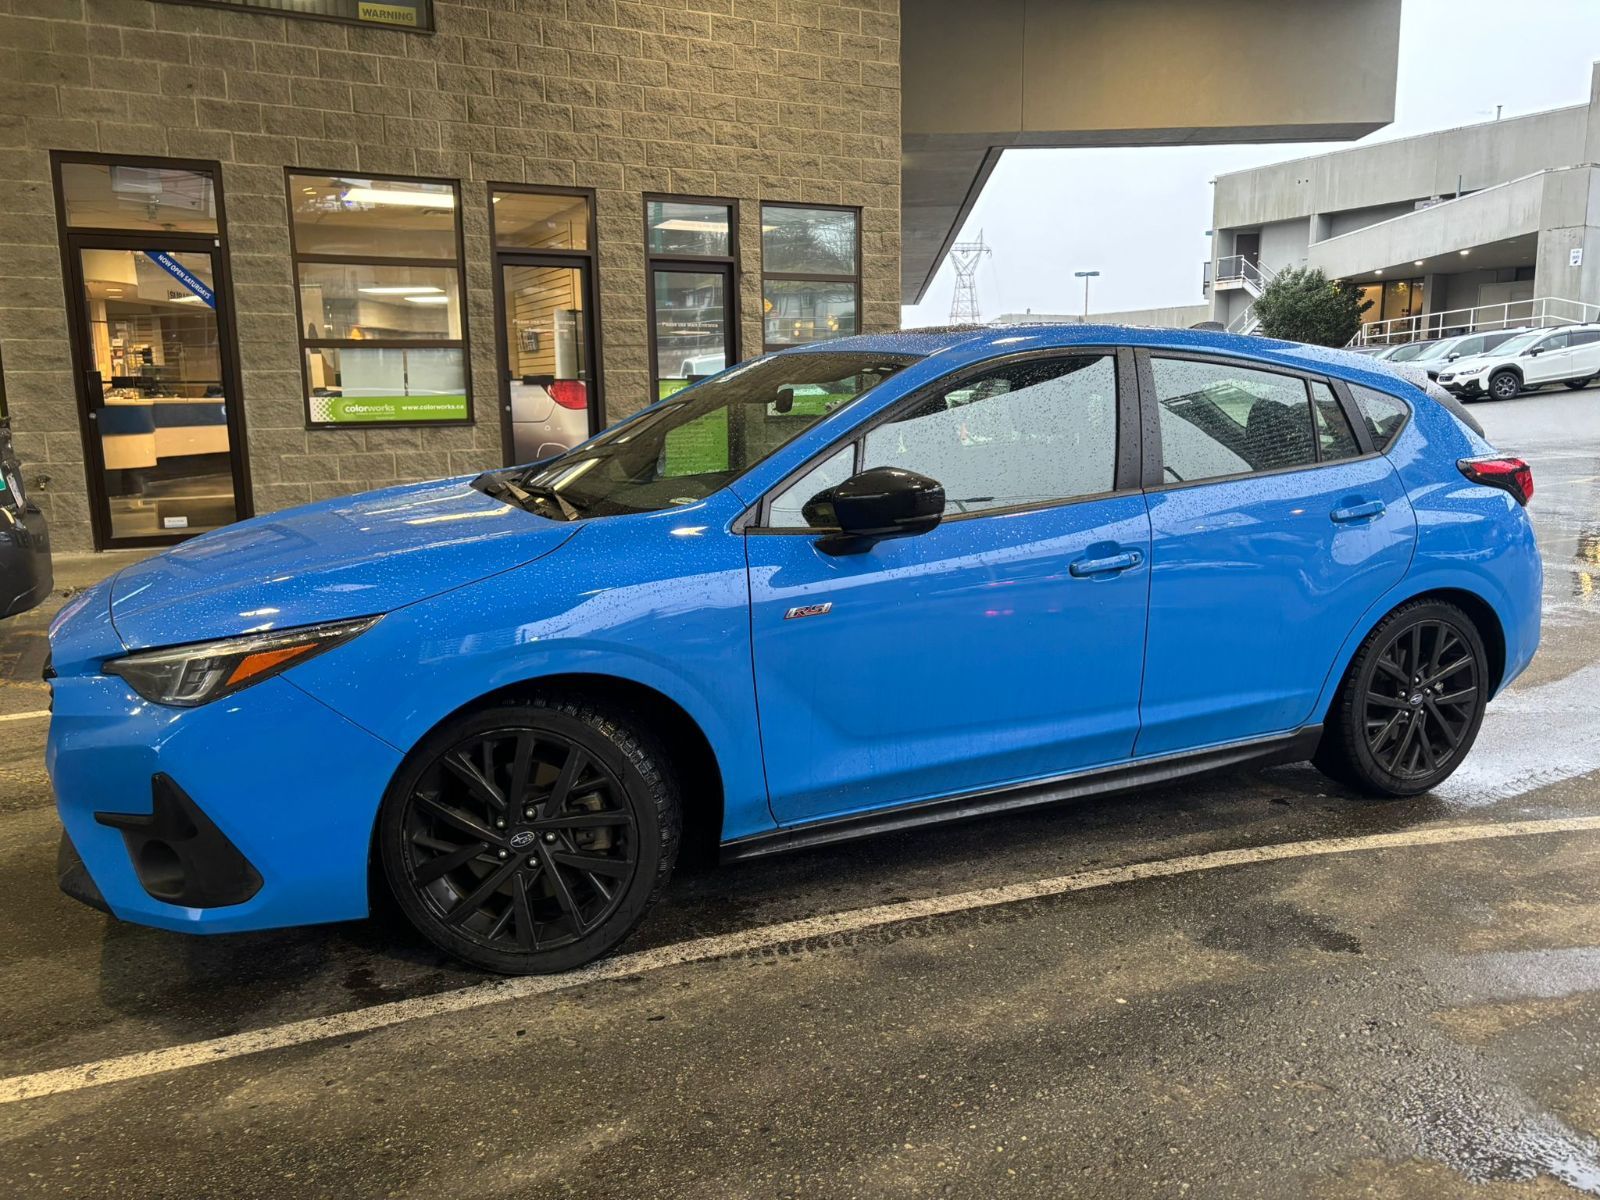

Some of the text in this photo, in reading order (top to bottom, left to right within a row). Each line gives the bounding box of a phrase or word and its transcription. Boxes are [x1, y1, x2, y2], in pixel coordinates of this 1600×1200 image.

[362, 8, 413, 21] WARNING
[158, 255, 211, 299] NOW OPEN SATURDAYS
[345, 404, 395, 412] colorworks
